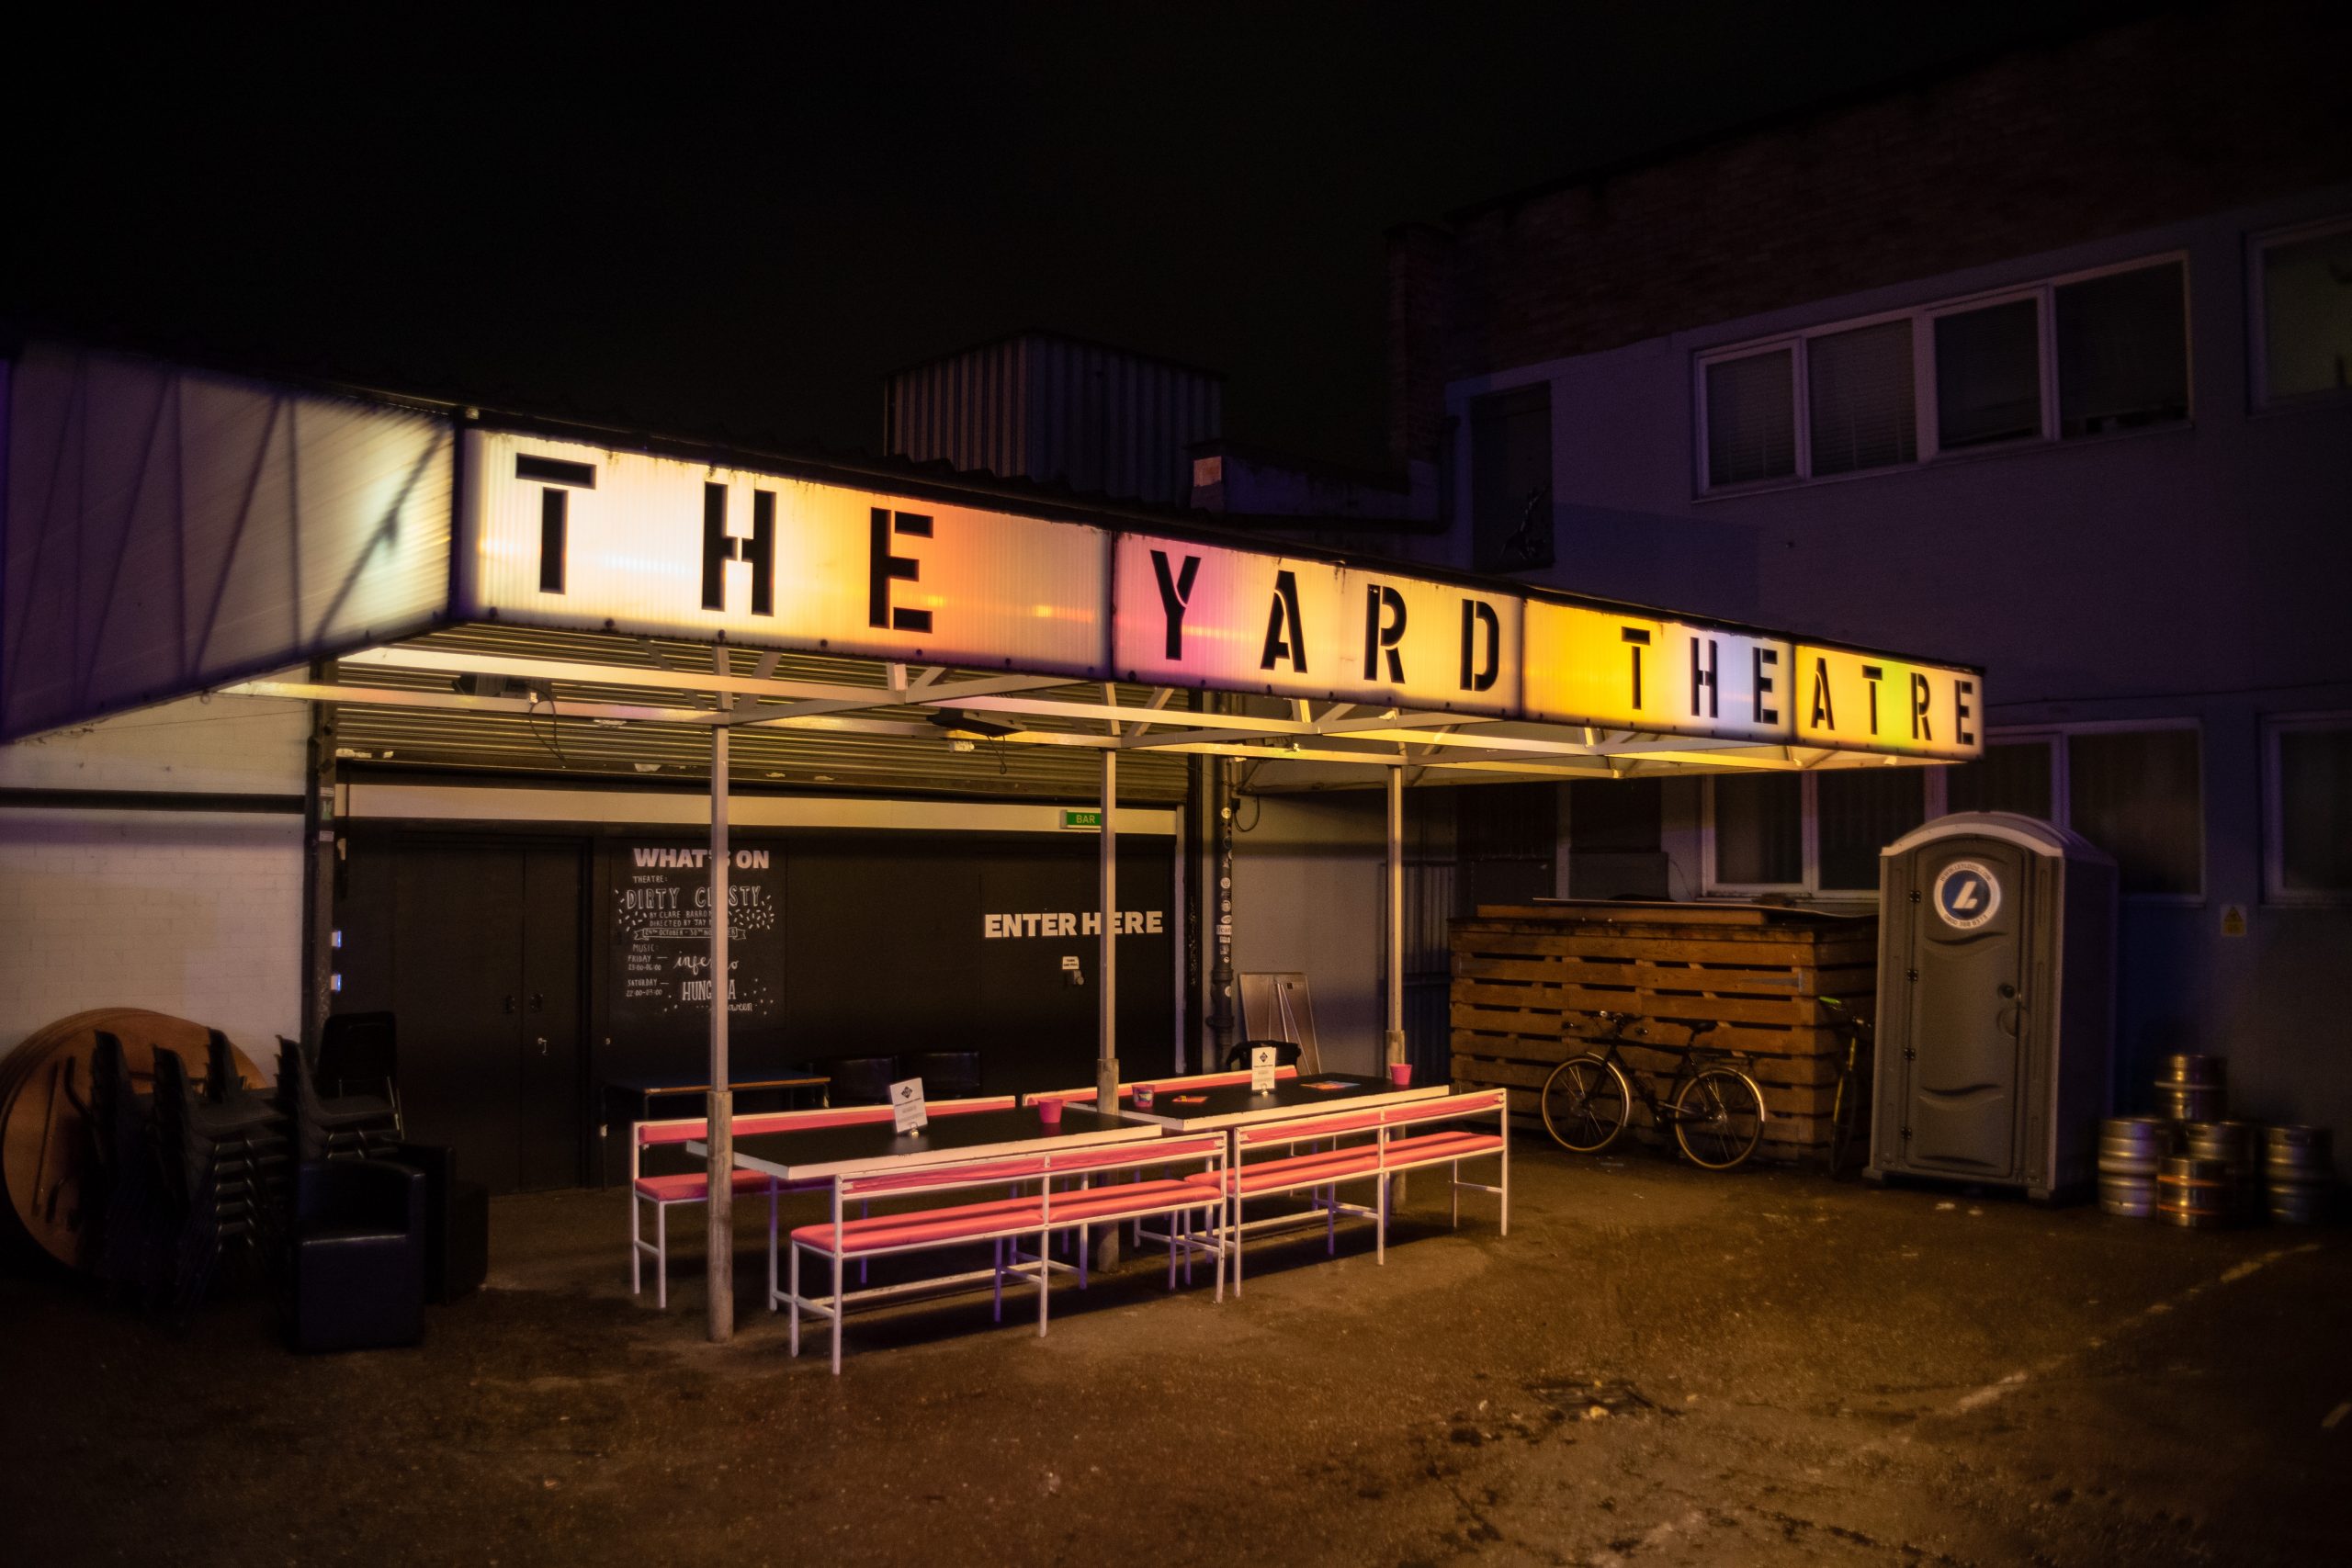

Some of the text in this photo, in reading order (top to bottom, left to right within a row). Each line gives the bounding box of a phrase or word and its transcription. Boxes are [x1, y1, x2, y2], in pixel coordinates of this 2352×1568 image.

[515, 453, 1975, 746] THE YARD THEATRE
[1076, 814, 1096, 825] BAR
[736, 850, 771, 869] ON
[632, 874, 669, 885] THEATRE:
[627, 885, 762, 909] DIRTY CSTY
[650, 919, 682, 928] DIRECTED
[660, 910, 681, 919] CLARE
[984, 912, 1078, 938] ENTER
[628, 950, 740, 976] FRIDAY infeo
[628, 978, 737, 1001] SATURDAY HUNGA
